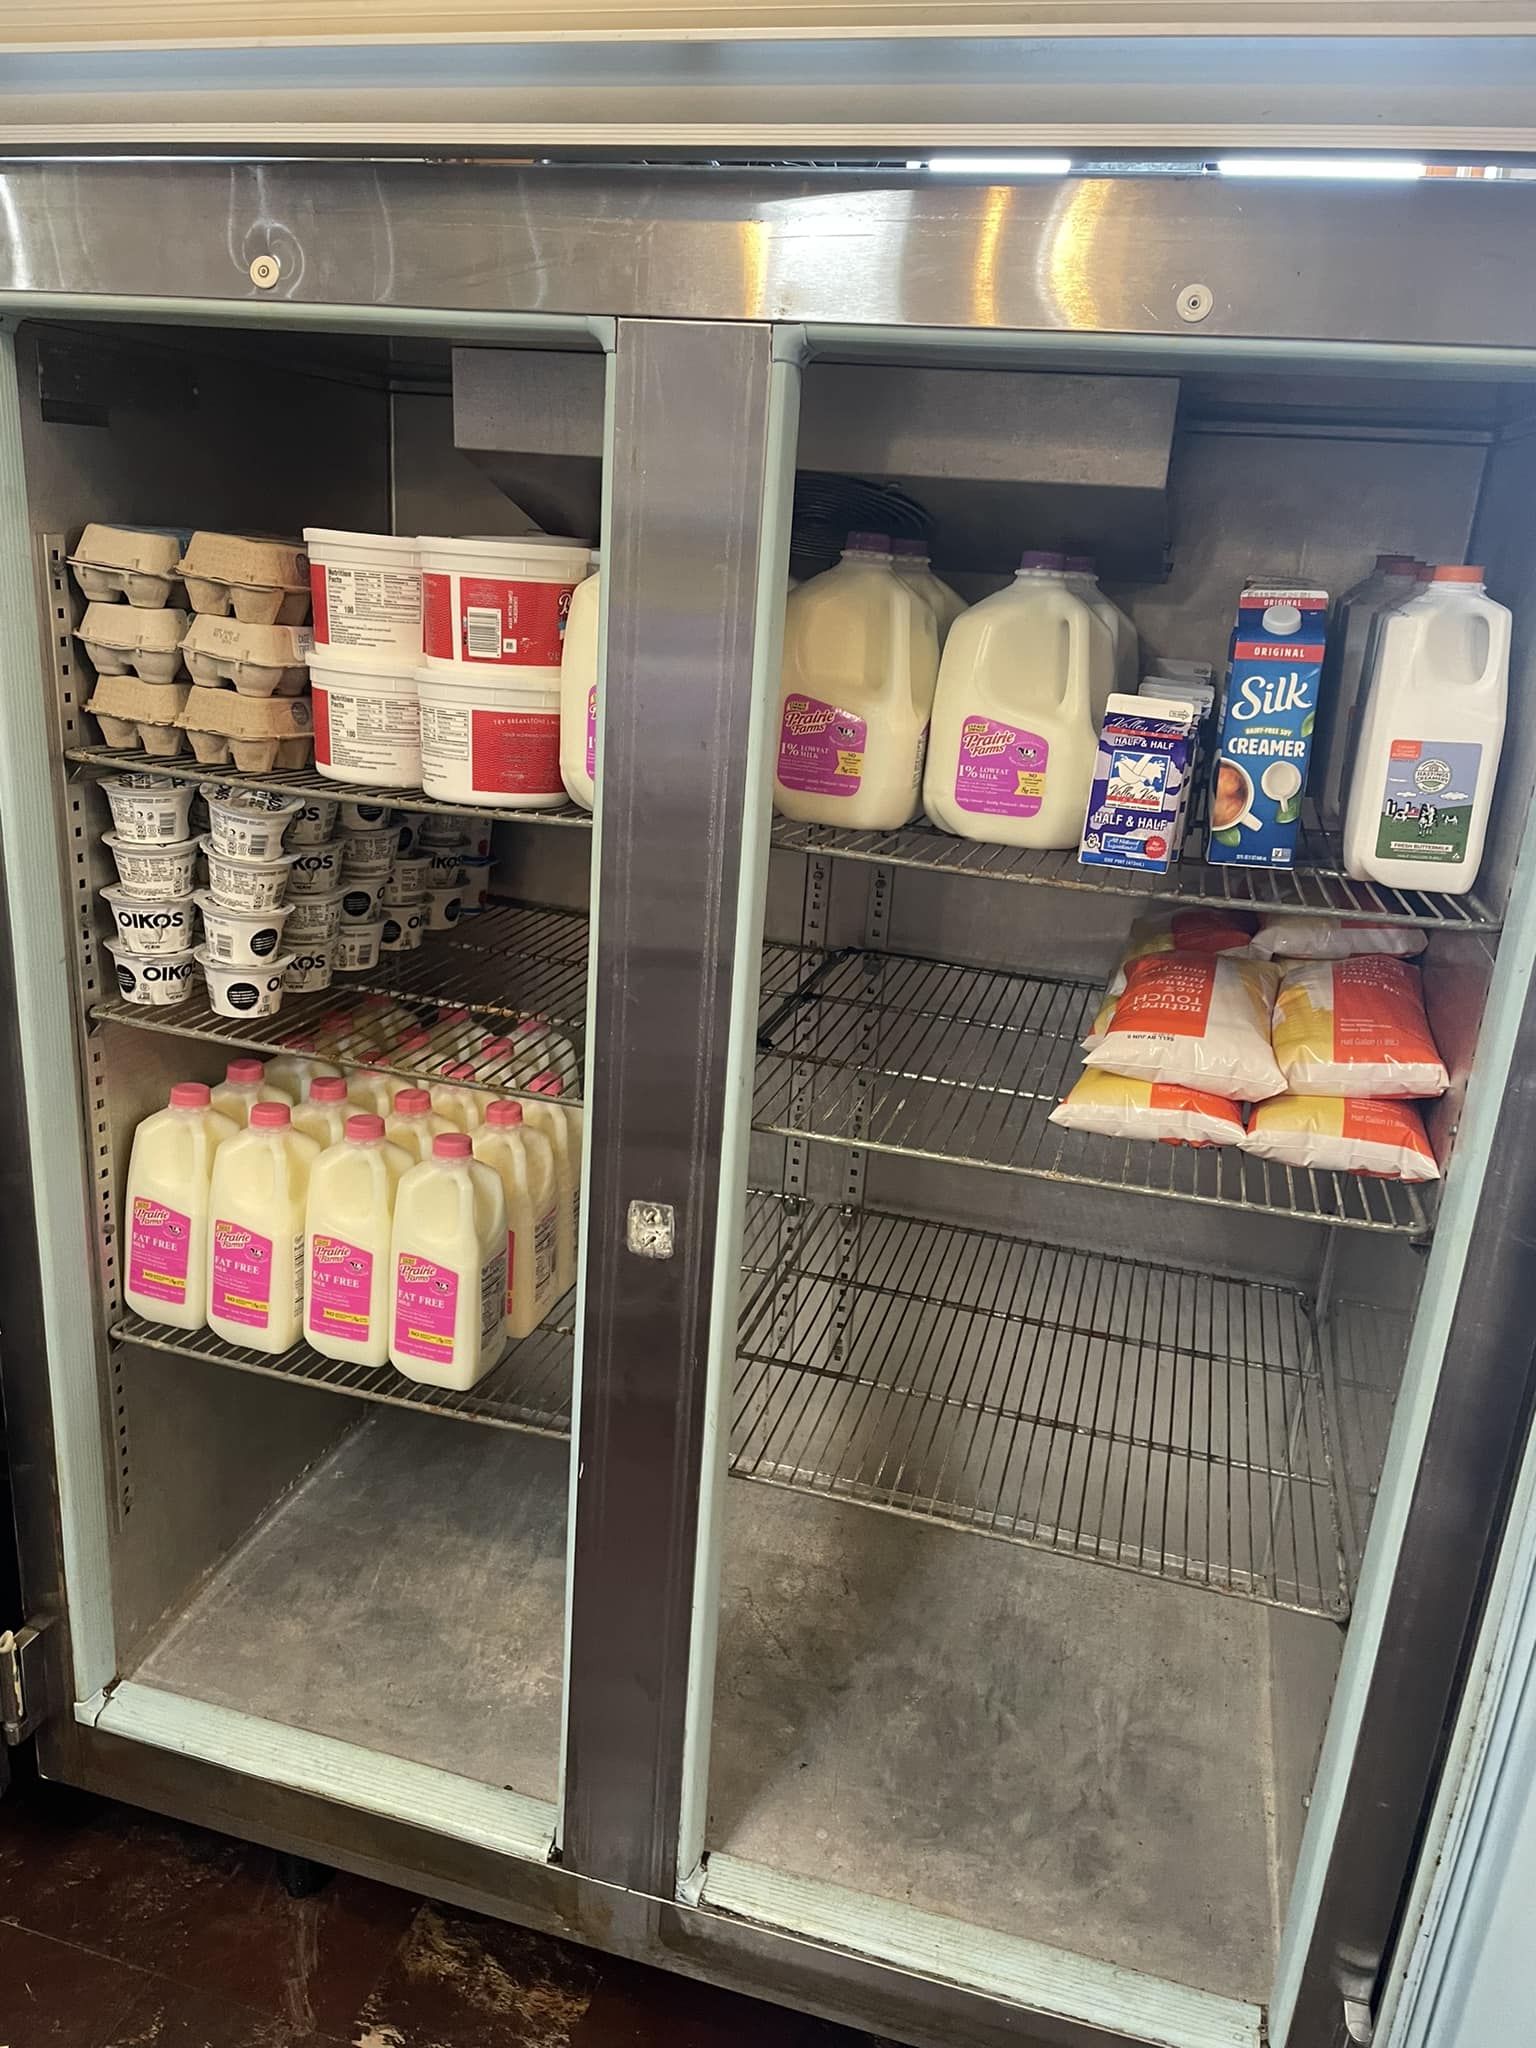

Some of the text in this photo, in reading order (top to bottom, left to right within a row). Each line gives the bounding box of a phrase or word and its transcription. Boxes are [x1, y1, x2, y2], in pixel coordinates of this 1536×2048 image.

[1264, 599, 1301, 608] ORIGINAL
[1254, 647, 1304, 657] ORIGINAL
[1232, 672, 1312, 720] Silk
[785, 709, 834, 727] Prairie
[791, 724, 825, 736] Farms
[963, 731, 1015, 749] Prairie
[1114, 736, 1174, 750] HALF & HALF
[1228, 737, 1306, 757] CREAMER
[781, 743, 799, 756] 1%
[969, 745, 1005, 758] Farms
[959, 764, 1009, 778] 1% LOWFAT
[1110, 783, 1136, 798] Valley
[1094, 811, 1168, 831] HALF & HALF
[292, 855, 333, 871] KOS
[118, 911, 184, 929] OIKOS
[286, 955, 326, 971] KOS
[142, 963, 192, 982] OIKO
[1133, 992, 1204, 1007] TOUCH
[1133, 1001, 1202, 1013] nature's
[134, 1208, 168, 1220] Prairie
[133, 1232, 177, 1251] FAT FREE
[216, 1231, 250, 1242] Prairie
[315, 1246, 350, 1257] Prairie
[215, 1255, 260, 1275] FAT FREE
[400, 1265, 436, 1276] Prairie
[312, 1270, 360, 1289] FAT FREE
[398, 1289, 445, 1309] FAT FREE
